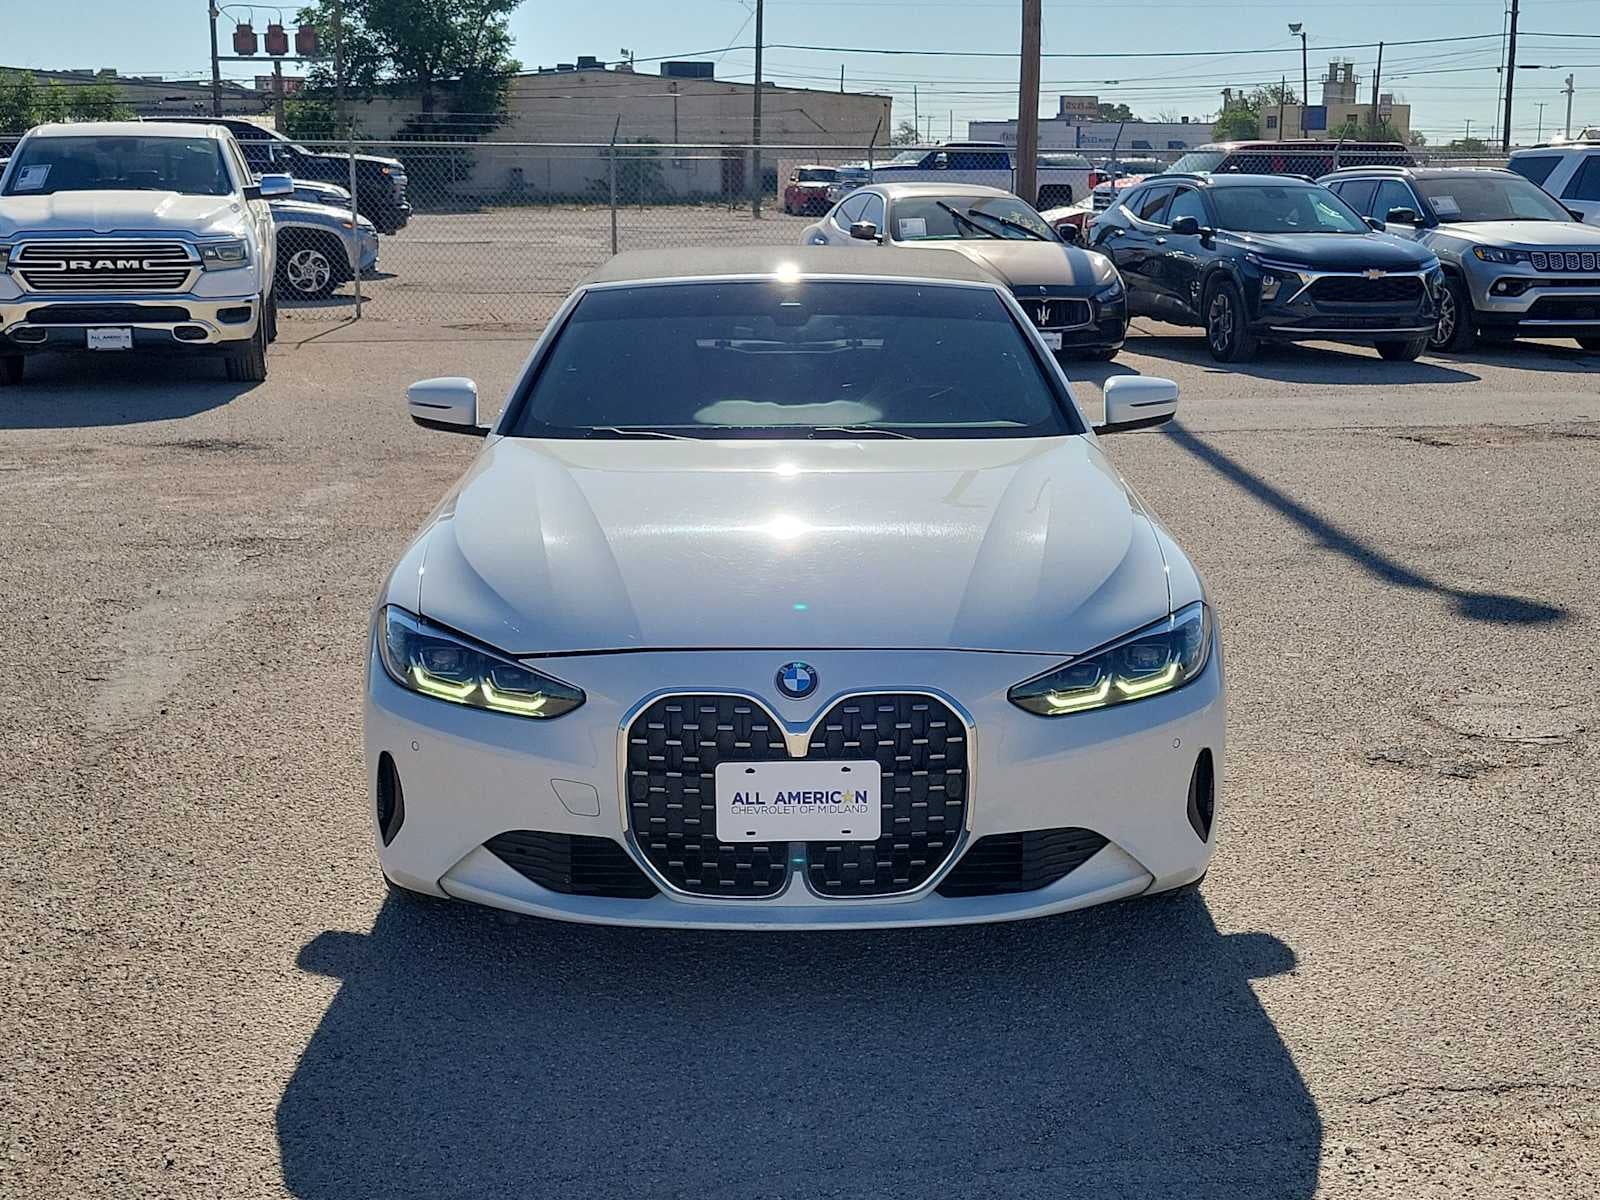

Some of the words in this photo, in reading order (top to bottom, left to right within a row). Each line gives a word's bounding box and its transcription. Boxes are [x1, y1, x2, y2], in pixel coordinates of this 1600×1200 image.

[69, 260, 140, 269] RAM
[731, 791, 766, 806] ALL
[731, 805, 797, 815] CHEVROLET
[799, 805, 815, 815] OF
[817, 804, 868, 814] MIDLAND
